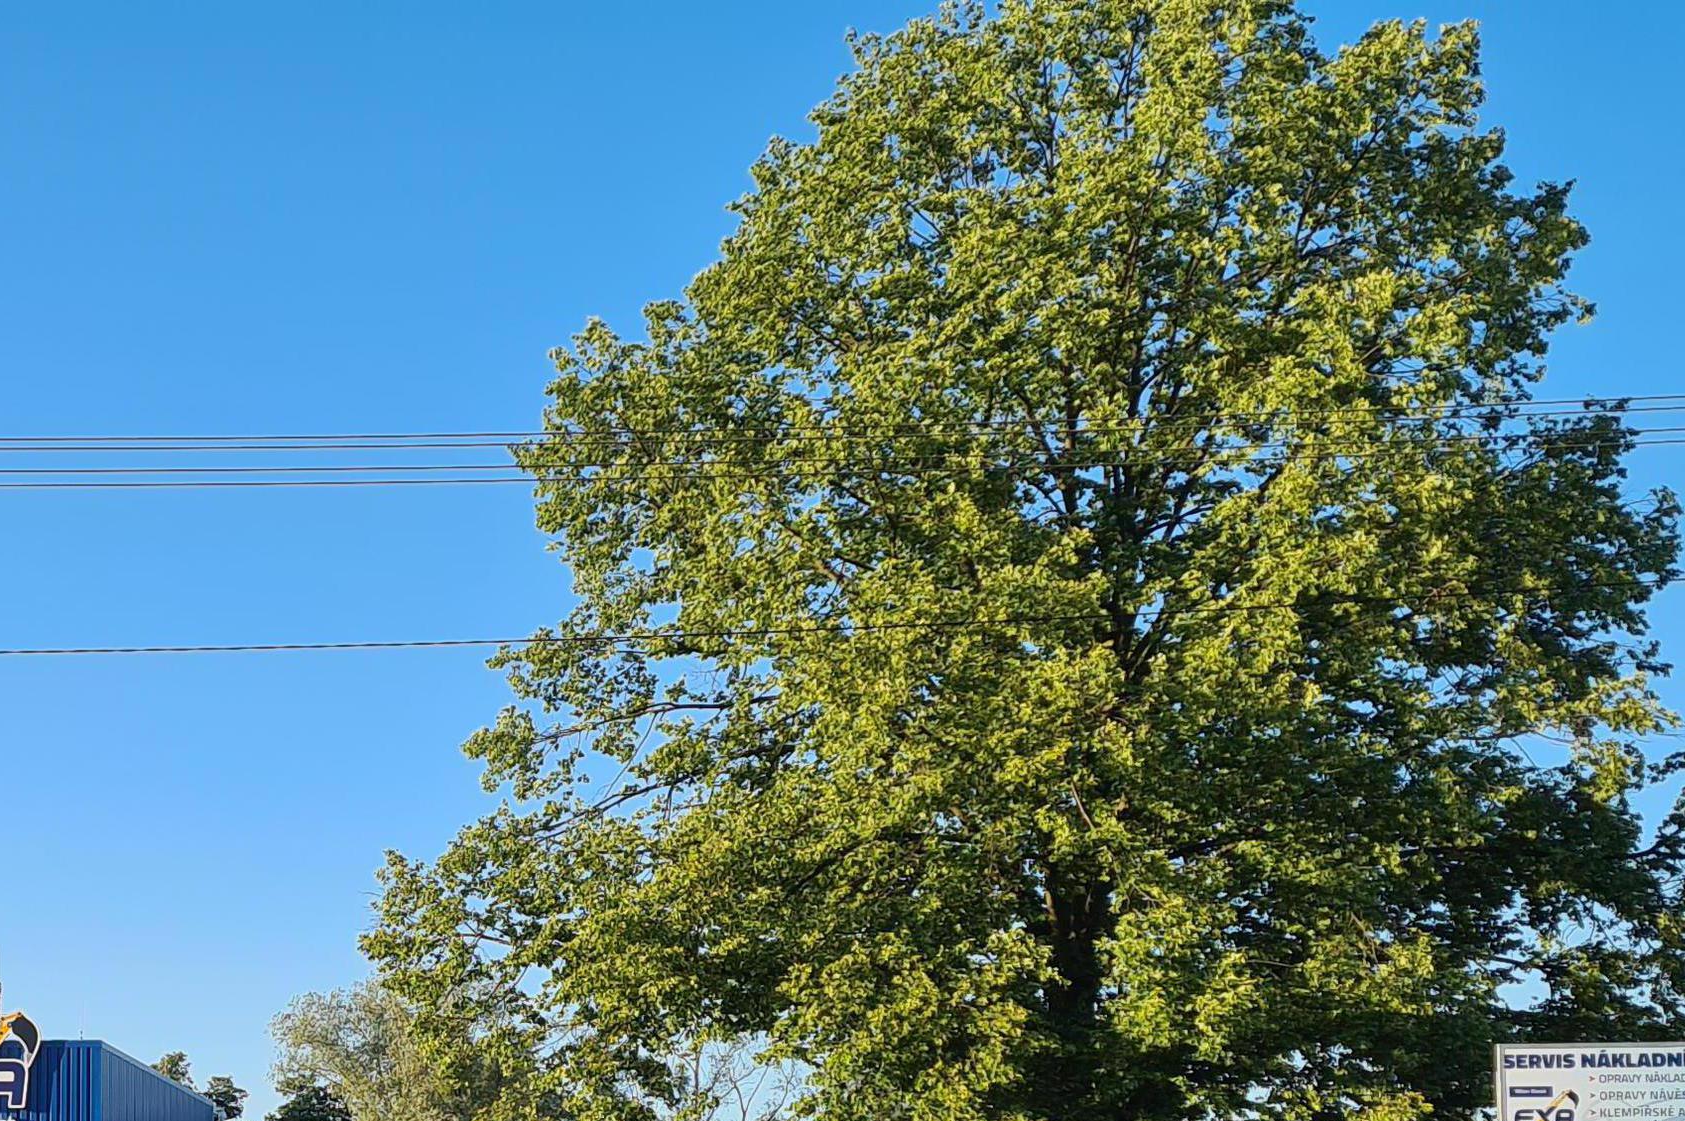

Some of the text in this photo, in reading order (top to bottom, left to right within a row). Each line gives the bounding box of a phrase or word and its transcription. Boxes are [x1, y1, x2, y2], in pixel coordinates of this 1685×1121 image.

[1504, 1053, 1576, 1069] SERVIS
[1598, 1073, 1642, 1084] OPRAVY
[1599, 1090, 1646, 1101] OPRAVY
